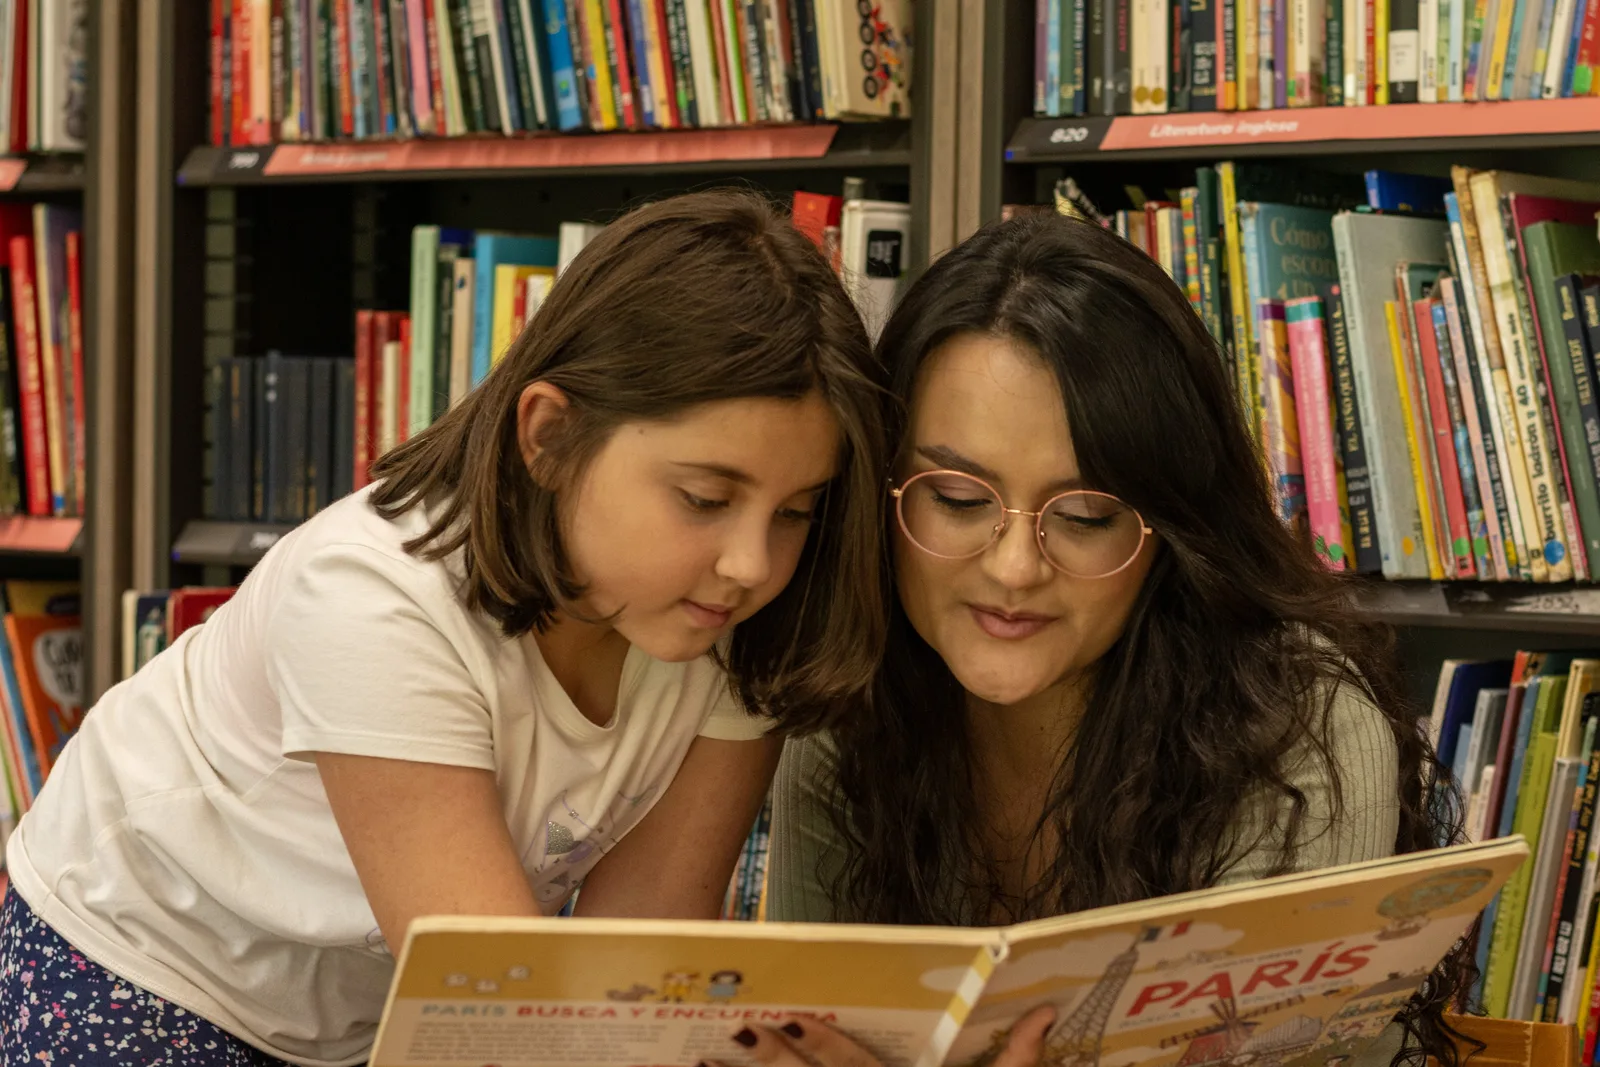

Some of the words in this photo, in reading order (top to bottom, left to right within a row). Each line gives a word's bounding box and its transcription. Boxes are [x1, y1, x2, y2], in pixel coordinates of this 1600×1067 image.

[1050, 127, 1089, 143] 820
[1149, 121, 1234, 139] Literatura
[1236, 118, 1299, 135] inglesa
[1516, 385, 1529, 406] 40
[1524, 423, 1544, 478] ladrón
[1126, 941, 1379, 1017] PARÍS
[421, 1004, 507, 1017] PARÍS
[516, 1004, 619, 1018] BUSCA
[628, 1006, 648, 1018] Y
